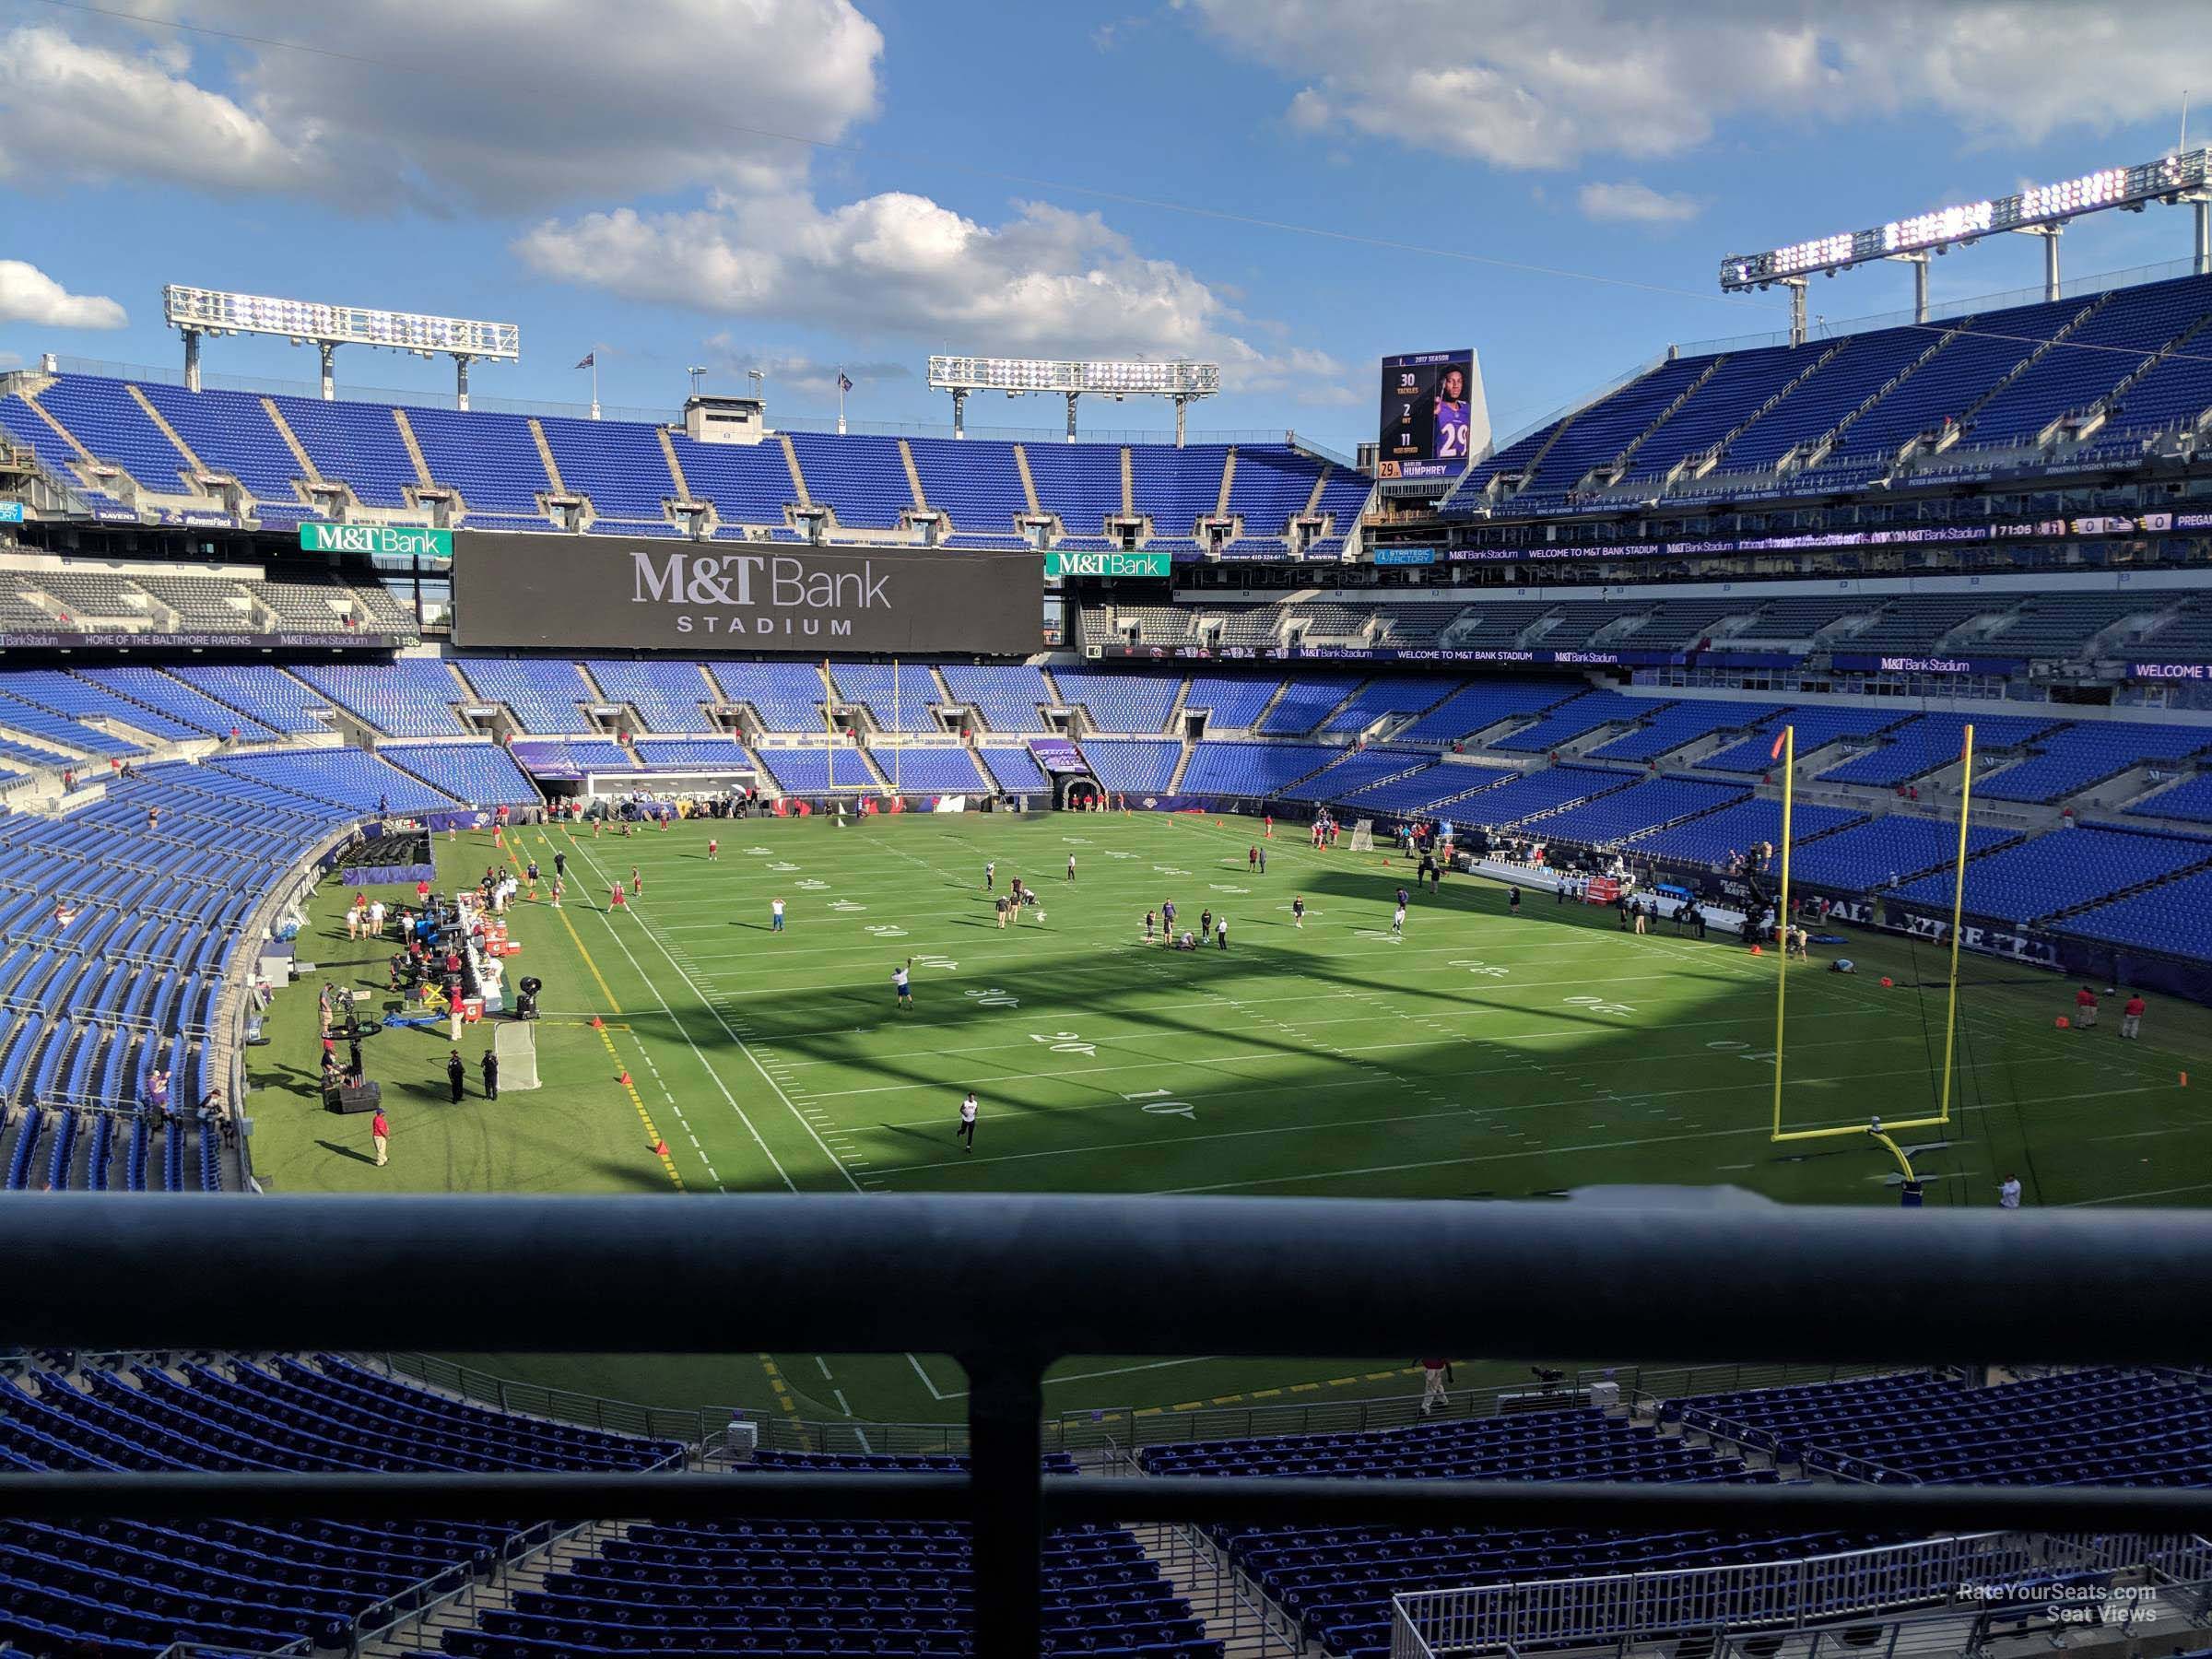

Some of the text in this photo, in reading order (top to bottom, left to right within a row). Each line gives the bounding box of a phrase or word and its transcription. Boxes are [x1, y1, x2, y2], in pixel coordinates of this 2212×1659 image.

[1401, 373, 1415, 386] 30
[1403, 404, 1411, 416] 2
[1401, 434, 1411, 446] 11
[1439, 423, 1467, 457] 29
[1381, 463, 1393, 477] 29
[1403, 465, 1447, 476] HUMPHREY
[2046, 465, 2080, 475] JONATHAN
[2081, 462, 2105, 471] OGDEN
[100, 512, 135, 520] RAVENS
[187, 516, 232, 527] #RavensFlock
[2086, 521, 2094, 532] 0
[2155, 517, 2164, 528] 0
[1925, 529, 1947, 540] Bank
[1947, 528, 1985, 539] Stadium
[1999, 524, 2032, 535] 71:06
[317, 525, 439, 553] M&T Bank
[1529, 545, 1658, 558] WELCOME TO M&T BANK STADIUM
[1685, 543, 1703, 552] Bank
[1704, 541, 1733, 551] Stadium
[1389, 555, 1430, 563] FACTORY
[1449, 551, 1468, 560] M&T
[1487, 550, 1519, 559] Stadium
[1058, 553, 1159, 575] M&T Bank
[631, 553, 892, 609] M&T Bank
[677, 616, 852, 635] STADIUM
[6, 635, 26, 645] Bank
[26, 635, 58, 645] Stadium
[86, 635, 251, 645] HOME OF THE BALTIMORE RAVENS
[280, 635, 367, 645] M&T Bank Stadium
[1300, 649, 1372, 658] M&T Bank Stadium
[1398, 650, 1532, 661] WELCOME TO M&T BANK STADIUM
[1555, 652, 1617, 662] M&T Bank Stadium
[1881, 658, 1969, 671] M&T Bank Stadium
[2136, 665, 2203, 678] WELCOME
